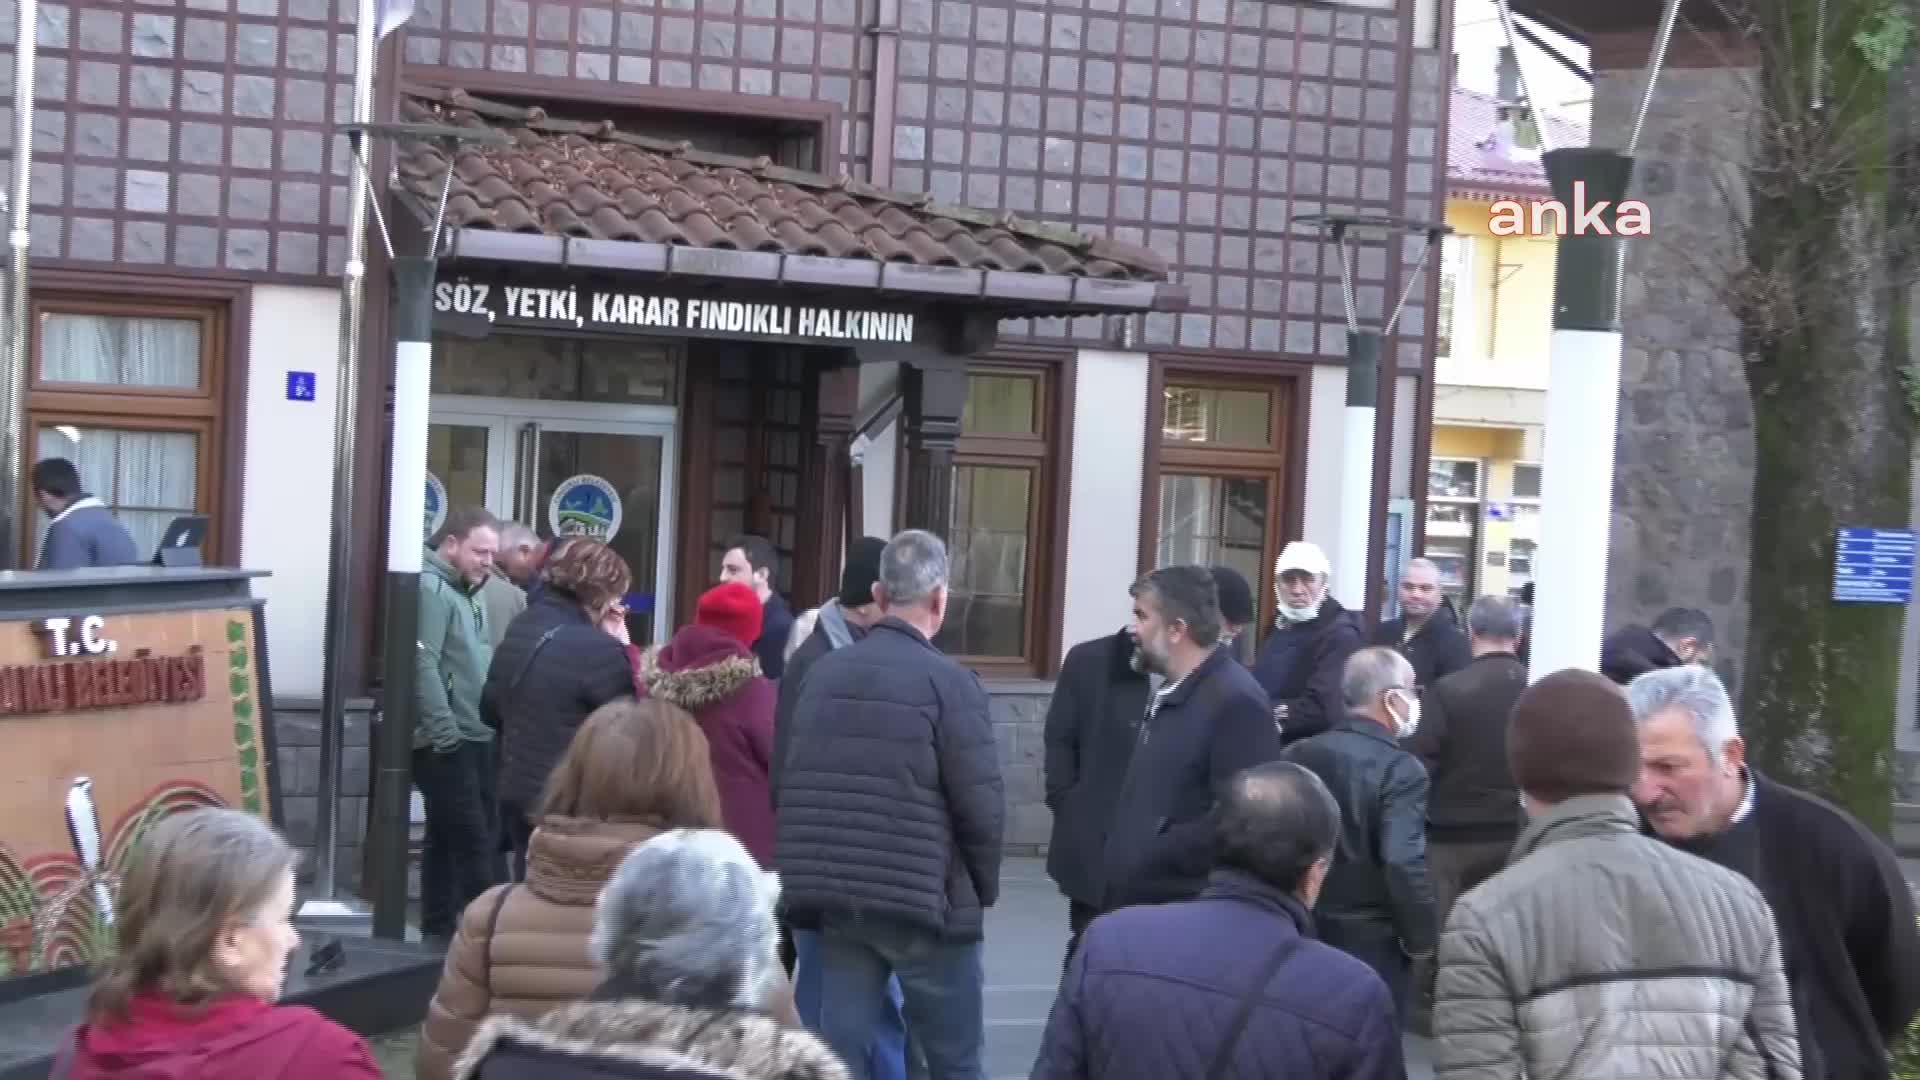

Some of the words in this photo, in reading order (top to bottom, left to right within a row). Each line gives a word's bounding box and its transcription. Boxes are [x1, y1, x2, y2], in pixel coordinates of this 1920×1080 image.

[434, 276, 496, 323] SÖZ,
[504, 284, 584, 328] YETKİ,
[591, 292, 680, 327] KARAR
[686, 298, 792, 335] FINDIKLI
[798, 306, 914, 342] HALKININ
[45, 615, 119, 656] T.C.
